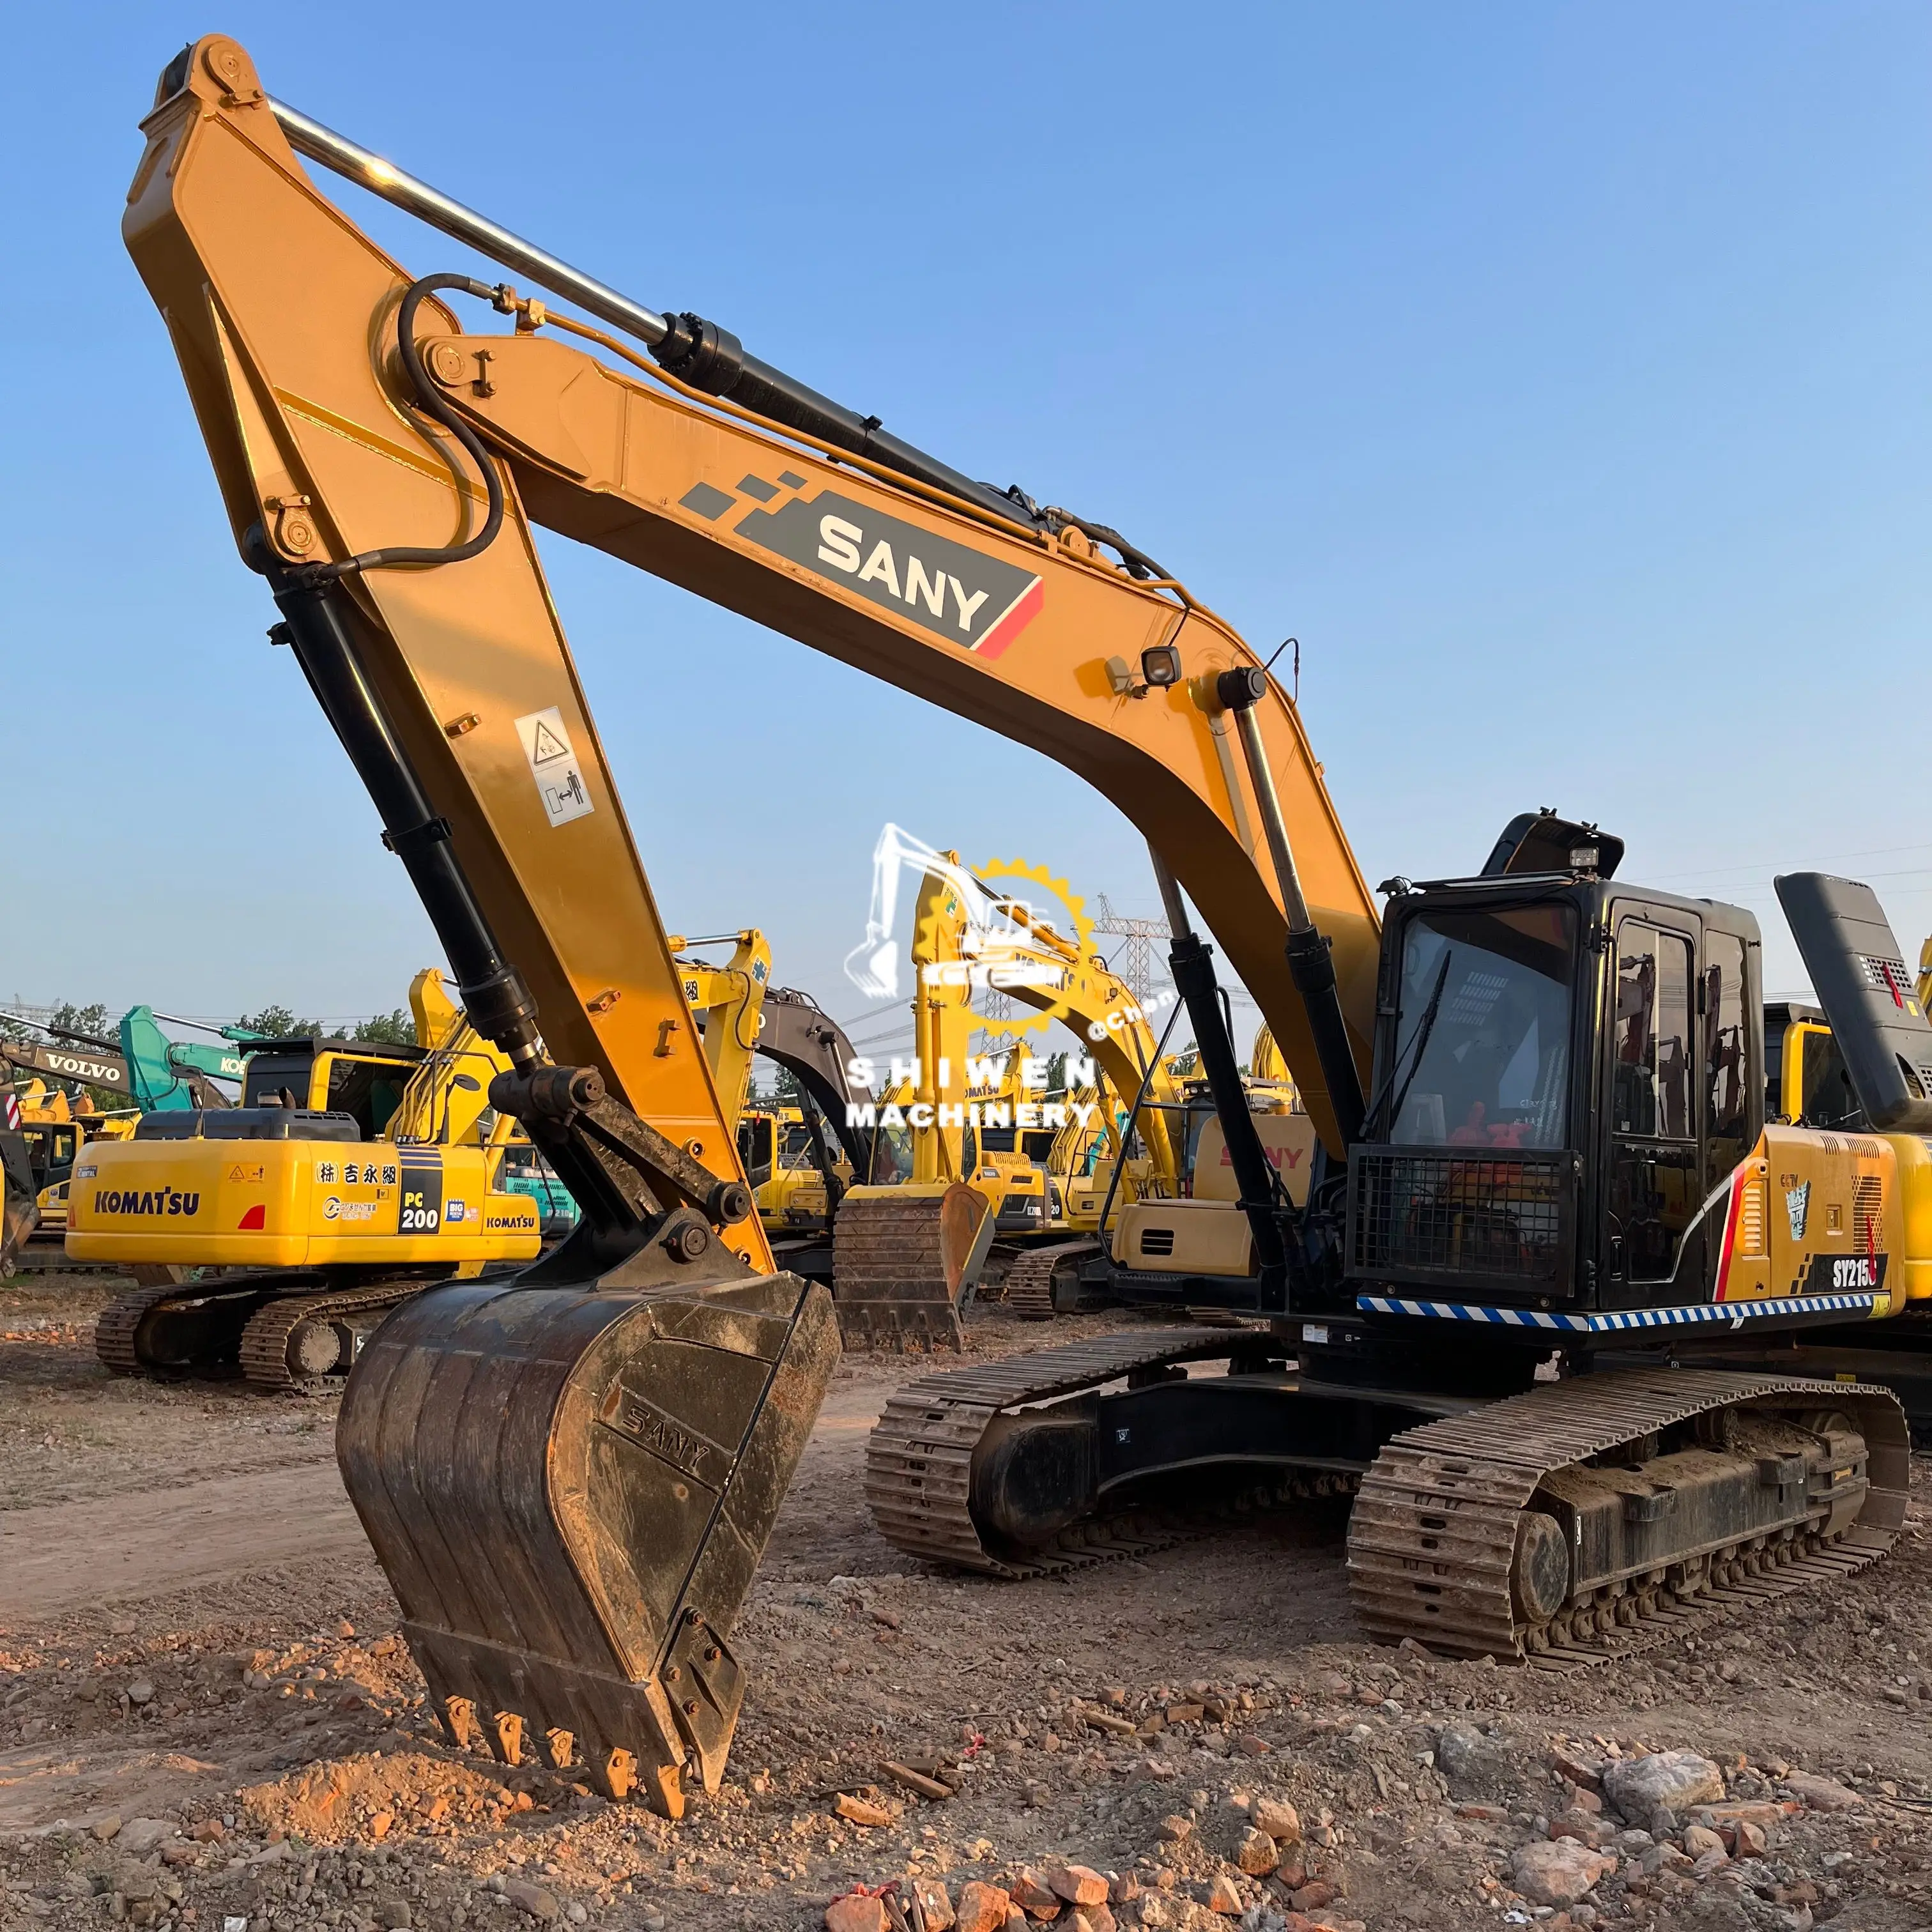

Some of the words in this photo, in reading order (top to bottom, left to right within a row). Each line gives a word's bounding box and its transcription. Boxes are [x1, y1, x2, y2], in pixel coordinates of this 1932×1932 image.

[818, 514, 989, 632] SANY
[45, 1054, 120, 1082] VOLVO
[95, 1186, 200, 1215] KOMATSU
[404, 1192, 424, 1207] PC
[449, 1203, 463, 1212] BIG
[401, 1209, 438, 1229] 200
[487, 1215, 534, 1227] KOMATSU
[622, 1404, 710, 1468] SANY
